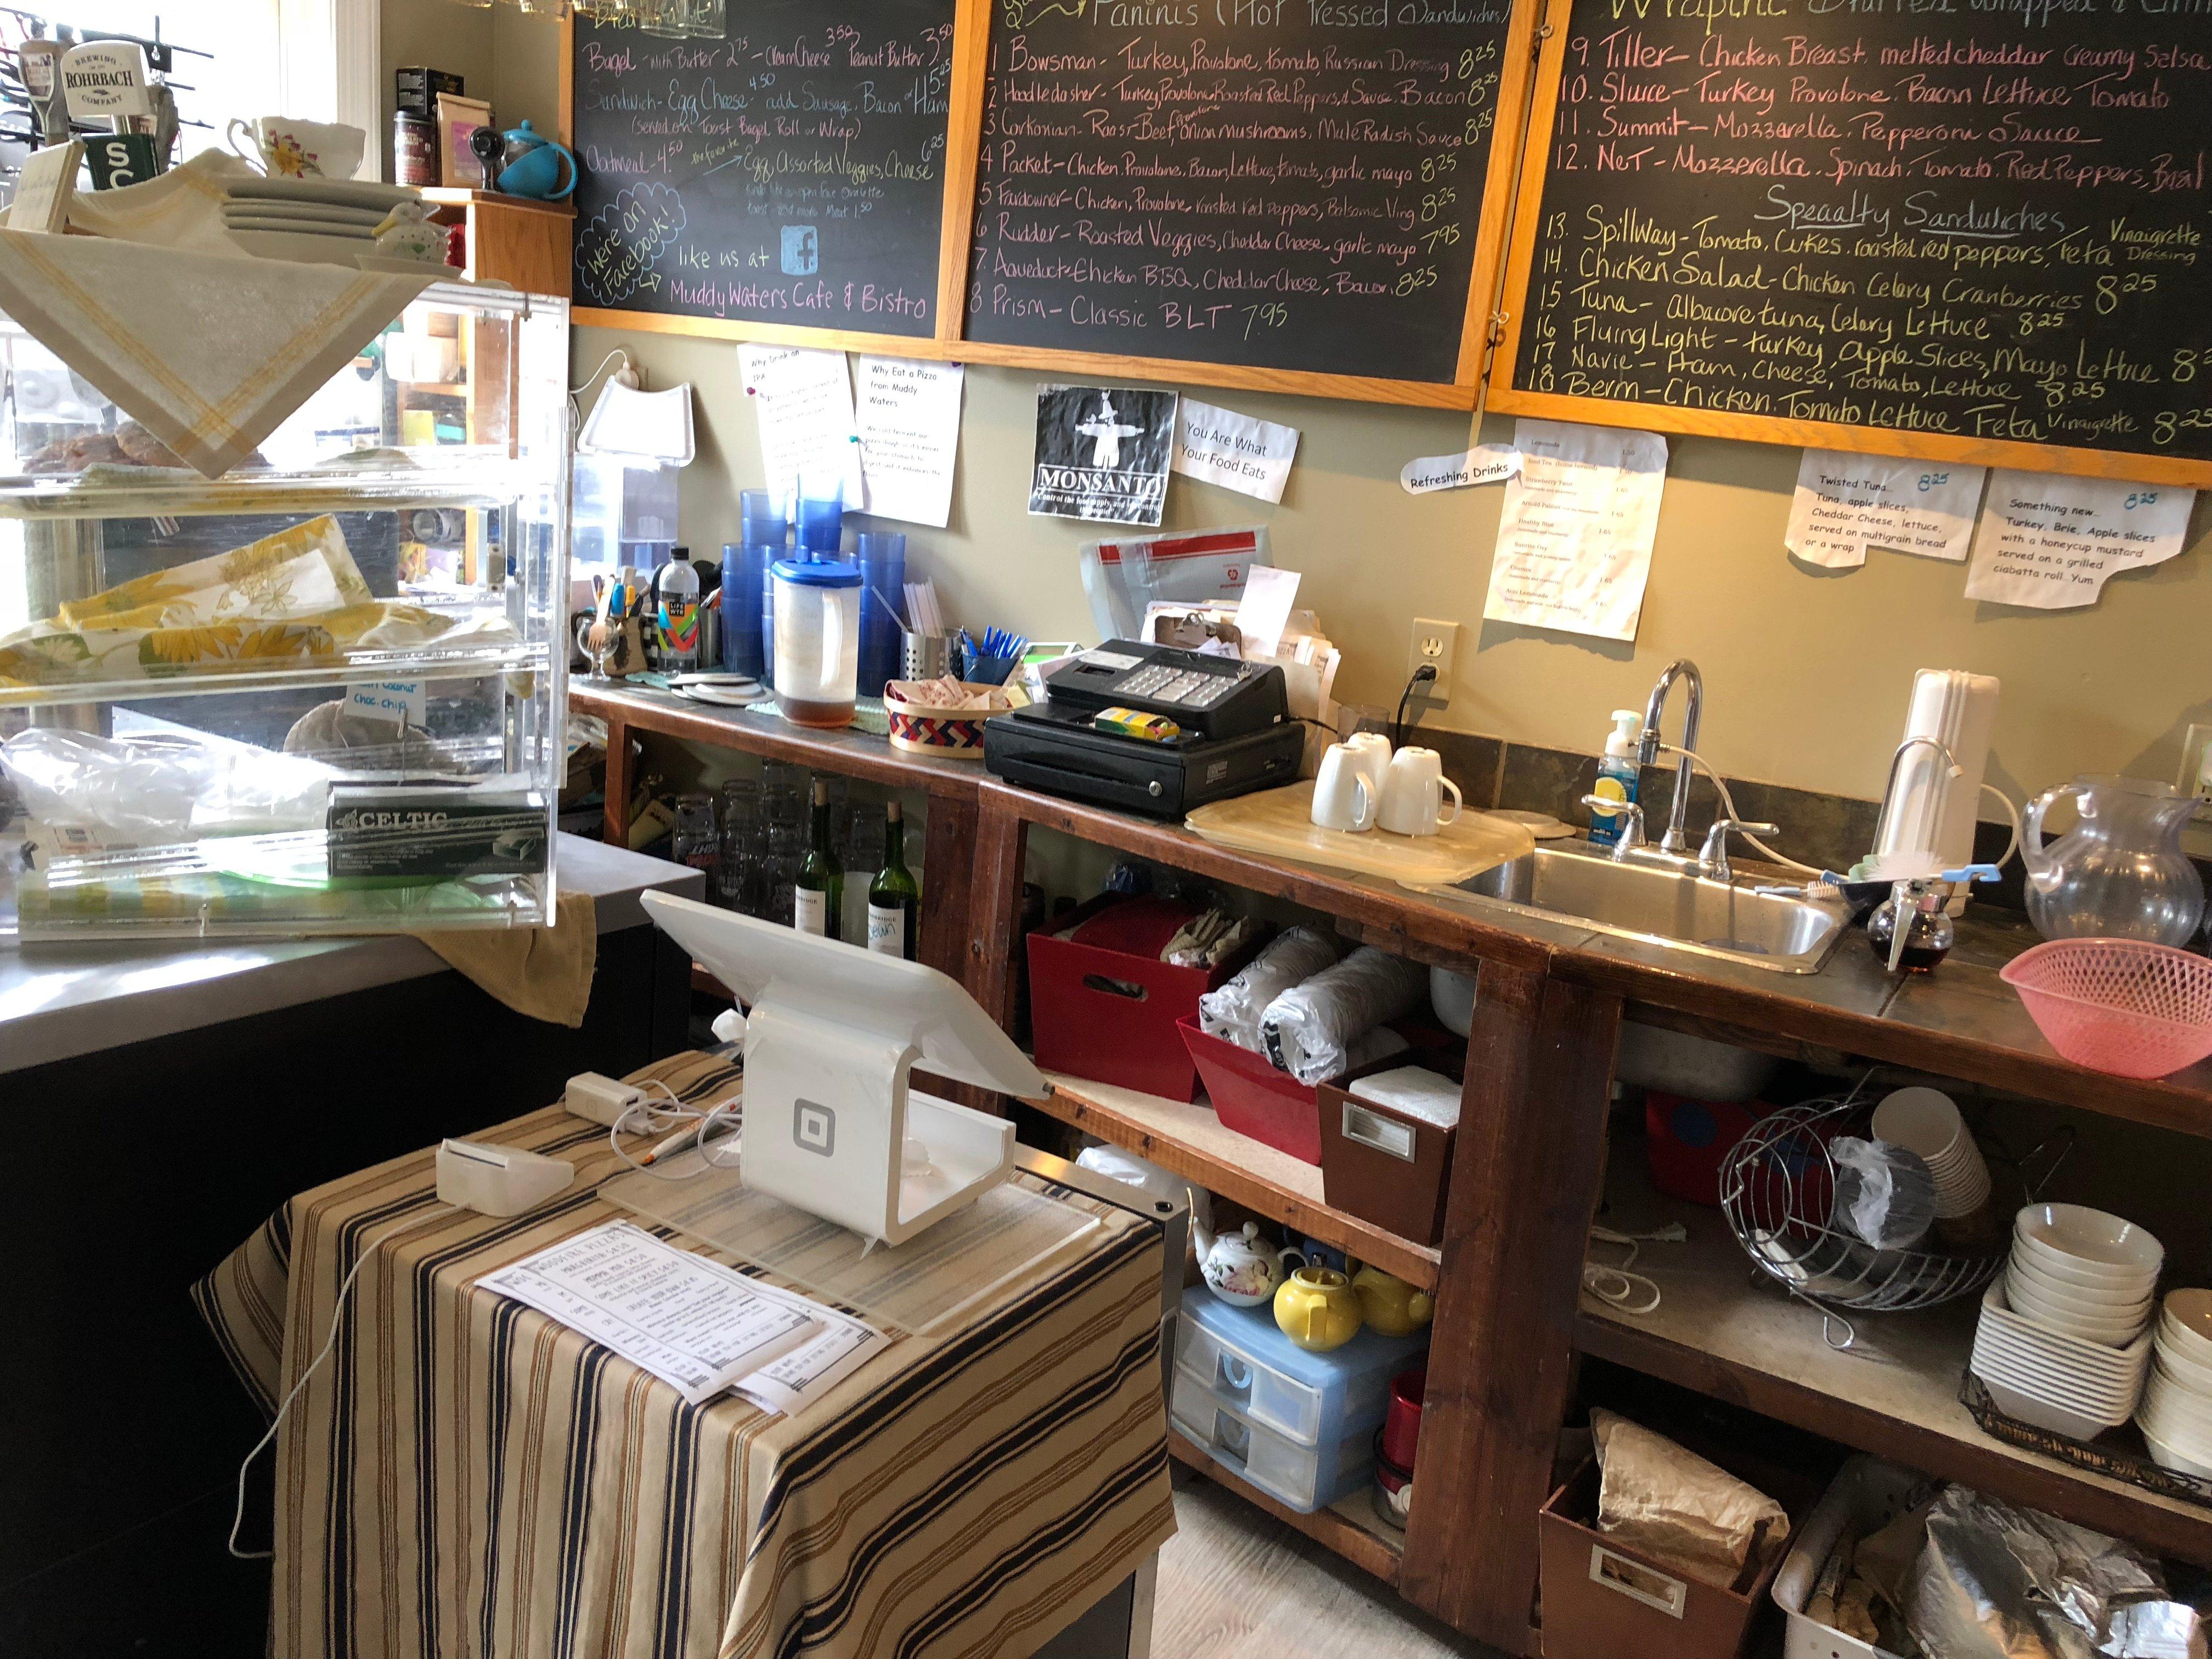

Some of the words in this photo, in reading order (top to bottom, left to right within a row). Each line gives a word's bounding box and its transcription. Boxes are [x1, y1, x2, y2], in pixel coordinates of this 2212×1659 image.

[75, 54, 117, 66] BREWING
[582, 42, 636, 78] Bagel
[671, 46, 720, 70] Butter
[885, 40, 925, 67] Butter
[1323, 44, 1383, 71] Russian
[1700, 34, 1781, 68] Chicken
[1881, 36, 1951, 66] melted
[1954, 38, 2055, 66] cheddar
[65, 70, 133, 89] ROHRBACH
[1394, 78, 1465, 106] Bacon
[81, 94, 122, 105] COMPANY
[854, 81, 902, 114] Bacon
[1694, 70, 1775, 116] Turkey
[1895, 74, 1973, 105] Bacon
[1982, 75, 2073, 106] Lettuce
[2073, 72, 2170, 109] Tomato
[774, 116, 800, 135] Roll
[1356, 119, 1413, 143] Radish
[1417, 122, 1463, 147] Sauce
[1848, 111, 1982, 151] Pepperoni
[777, 150, 833, 176] Assorted
[1994, 150, 2052, 180] Red
[2149, 149, 2204, 193] Basil
[1372, 167, 1413, 188] mayo
[1754, 184, 1891, 236] Specialty
[1904, 190, 2067, 233] Sandwiches
[1072, 218, 1144, 248] Roasted
[1330, 232, 1373, 264] garlic
[1376, 242, 1417, 267] mayo
[1921, 236, 1951, 261] red
[2111, 217, 2201, 246] Vinaigrette
[680, 244, 711, 269] like
[720, 250, 739, 268] us
[748, 245, 770, 268] at
[2127, 247, 2196, 266] Dressing
[1580, 247, 1668, 283] Chicken
[1782, 266, 1855, 295] Chicken
[1867, 272, 1930, 308] Celery
[1943, 278, 2083, 310] Cranberries
[670, 279, 725, 317] Muddy
[729, 281, 788, 311] Waters
[792, 281, 833, 310] Cafe
[862, 284, 928, 319] Bistro
[1071, 294, 1148, 328] Classic
[1158, 301, 1233, 330] BLT
[1906, 307, 1990, 340] Lettuce
[872, 365, 889, 377] Why
[892, 367, 905, 377] Eat
[917, 369, 937, 381] Pizza
[1994, 347, 2068, 383] Mayo
[2077, 338, 2160, 383] Lettuce
[871, 380, 889, 390] from
[892, 383, 918, 396] Muddy
[1931, 381, 2023, 402] Lettuce
[870, 396, 898, 407] Waters
[1778, 390, 1860, 424] Tomato
[1869, 400, 1960, 433] Lettuce
[1965, 403, 2049, 441] Feta
[2048, 407, 2140, 441] Vinaigrette
[1186, 421, 1207, 439] You
[1210, 430, 1232, 446] Are
[1235, 436, 1268, 458] What
[1181, 443, 1208, 463] Your
[1210, 453, 1240, 472] Food
[1242, 462, 1267, 482] Eats
[1040, 468, 1162, 496] MONSANTO
[1410, 469, 1468, 489] Refreshing
[1473, 463, 1509, 478] Drinks
[1820, 475, 1859, 489] Twisted
[1848, 498, 1874, 509] apple
[1878, 500, 1910, 514] slices,
[2009, 498, 2068, 516] Something
[1812, 507, 1854, 521] Cheddar
[1858, 514, 1897, 528] Cheese,
[1901, 518, 1943, 534] lettuce,
[1805, 538, 1816, 547] or
[1830, 543, 1855, 554] wrap
[1809, 523, 1842, 535] served
[1846, 529, 1858, 538] on
[1861, 531, 1911, 545] multigrain
[1915, 537, 1947, 549] bread
[2001, 533, 2024, 544] with
[2040, 536, 2092, 554] honeycup
[2096, 544, 2145, 558] mustard
[2087, 527, 2120, 540] Apple
[2124, 532, 2157, 543] slices
[1997, 549, 2035, 561] served
[2038, 555, 2051, 563] on
[2056, 557, 2063, 565] a
[2067, 557, 2104, 571] grilled
[1993, 563, 2040, 579] ciabatta
[2071, 573, 2094, 585] Yum
[358, 811, 448, 830] CELTIC
